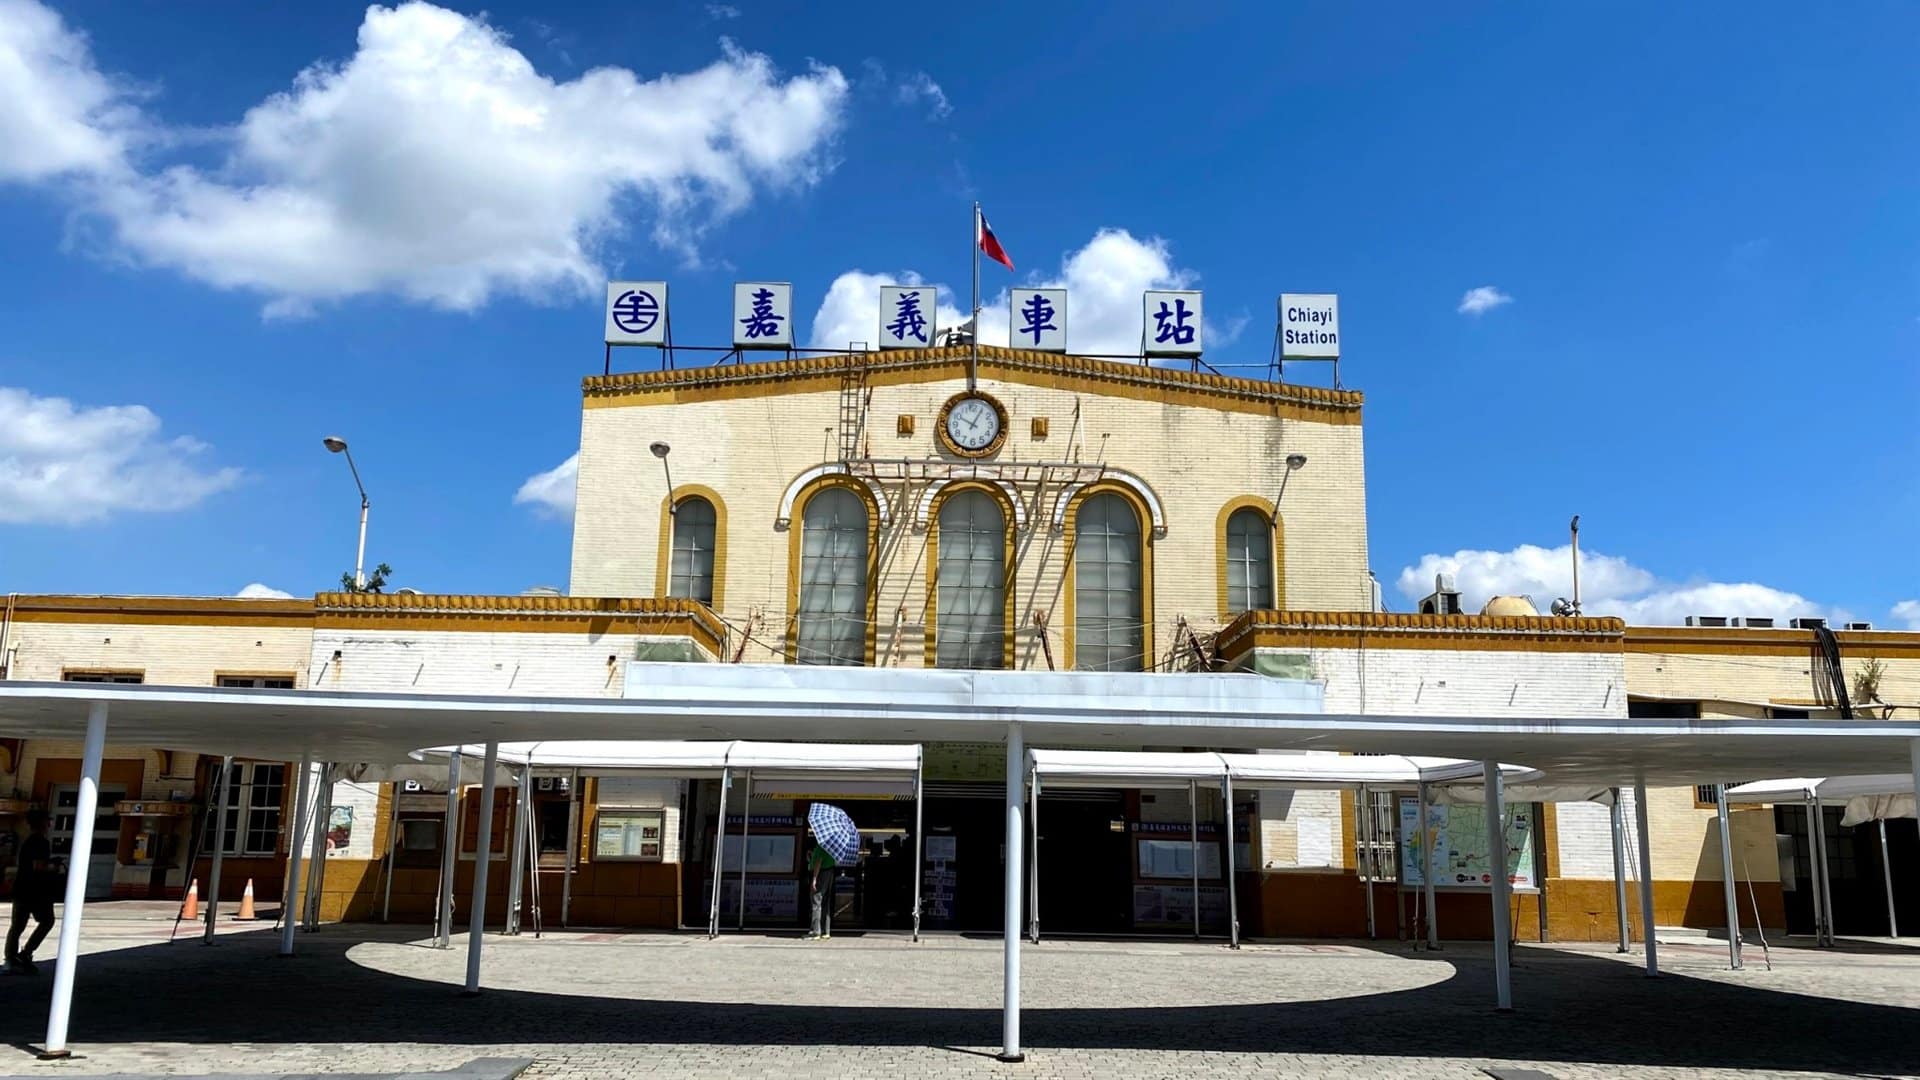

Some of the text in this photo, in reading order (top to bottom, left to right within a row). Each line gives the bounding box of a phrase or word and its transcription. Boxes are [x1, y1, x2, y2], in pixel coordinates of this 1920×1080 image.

[1288, 307, 1332, 326] Chiayi
[1285, 329, 1337, 344] Station
[952, 420, 958, 428] 9
[988, 421, 993, 429] 3
[955, 429, 960, 437] 8
[962, 435, 967, 443] 7
[970, 438, 976, 446] 6
[979, 436, 985, 444] 5
